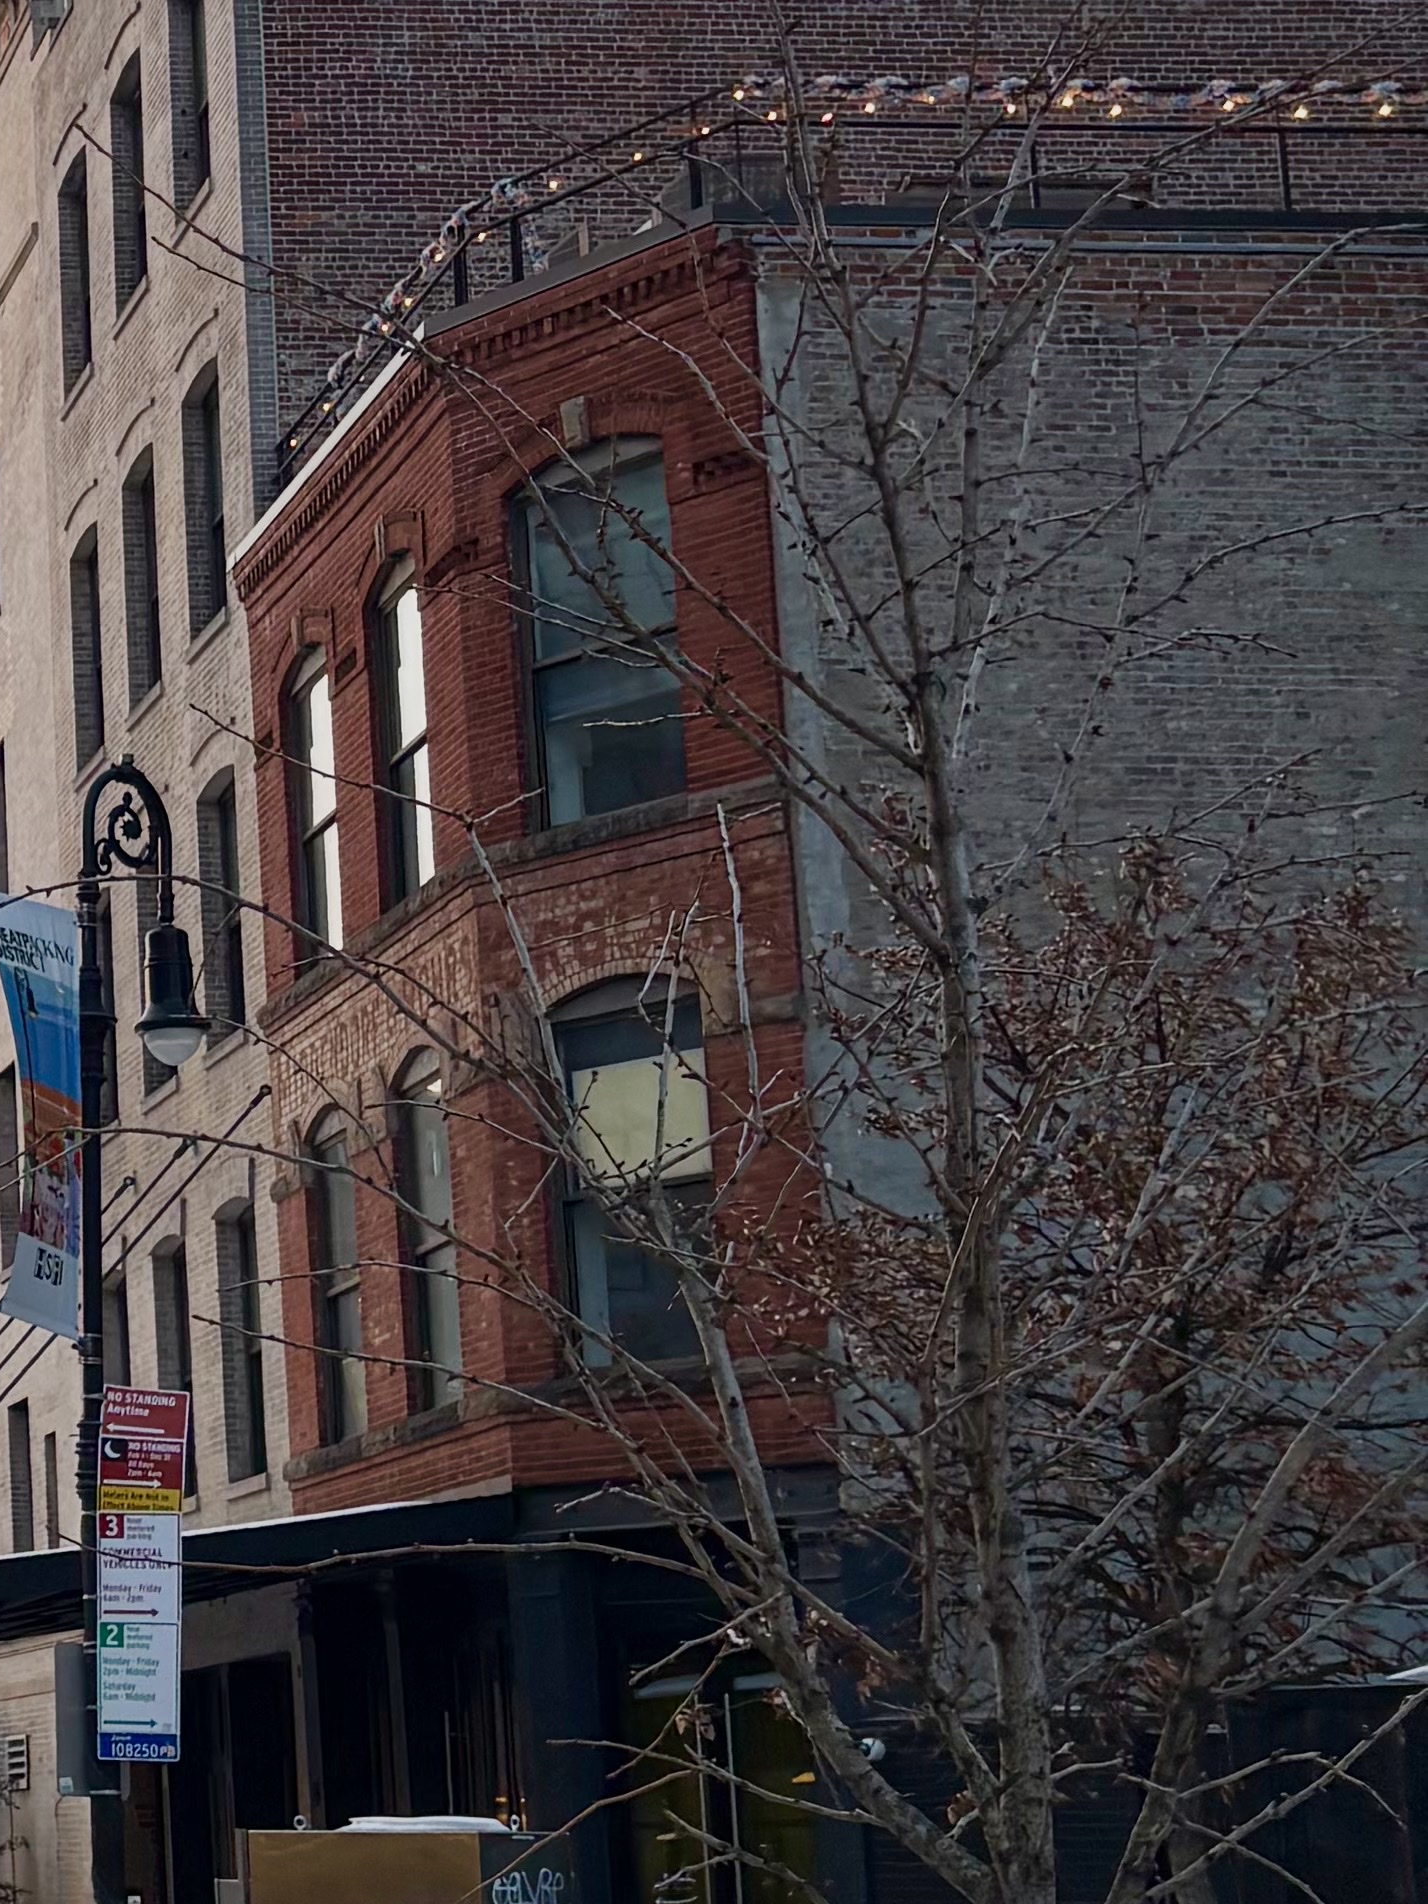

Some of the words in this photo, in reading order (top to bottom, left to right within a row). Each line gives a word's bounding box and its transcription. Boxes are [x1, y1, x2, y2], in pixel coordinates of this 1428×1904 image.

[106, 1390, 123, 1403] NO
[125, 1393, 177, 1407] STANDING
[106, 1402, 150, 1417] Anytime
[142, 1442, 181, 1453] STANDING
[105, 1515, 119, 1536] 3
[103, 1546, 163, 1558] COMMERCIAL
[103, 1558, 146, 1569] VEHICLES
[103, 1584, 131, 1595] Monday
[139, 1583, 162, 1594] Friday
[105, 1624, 119, 1646] 2
[137, 1657, 160, 1668] Friday
[103, 1682, 136, 1694] Saturday
[111, 1742, 159, 1757] 108250
